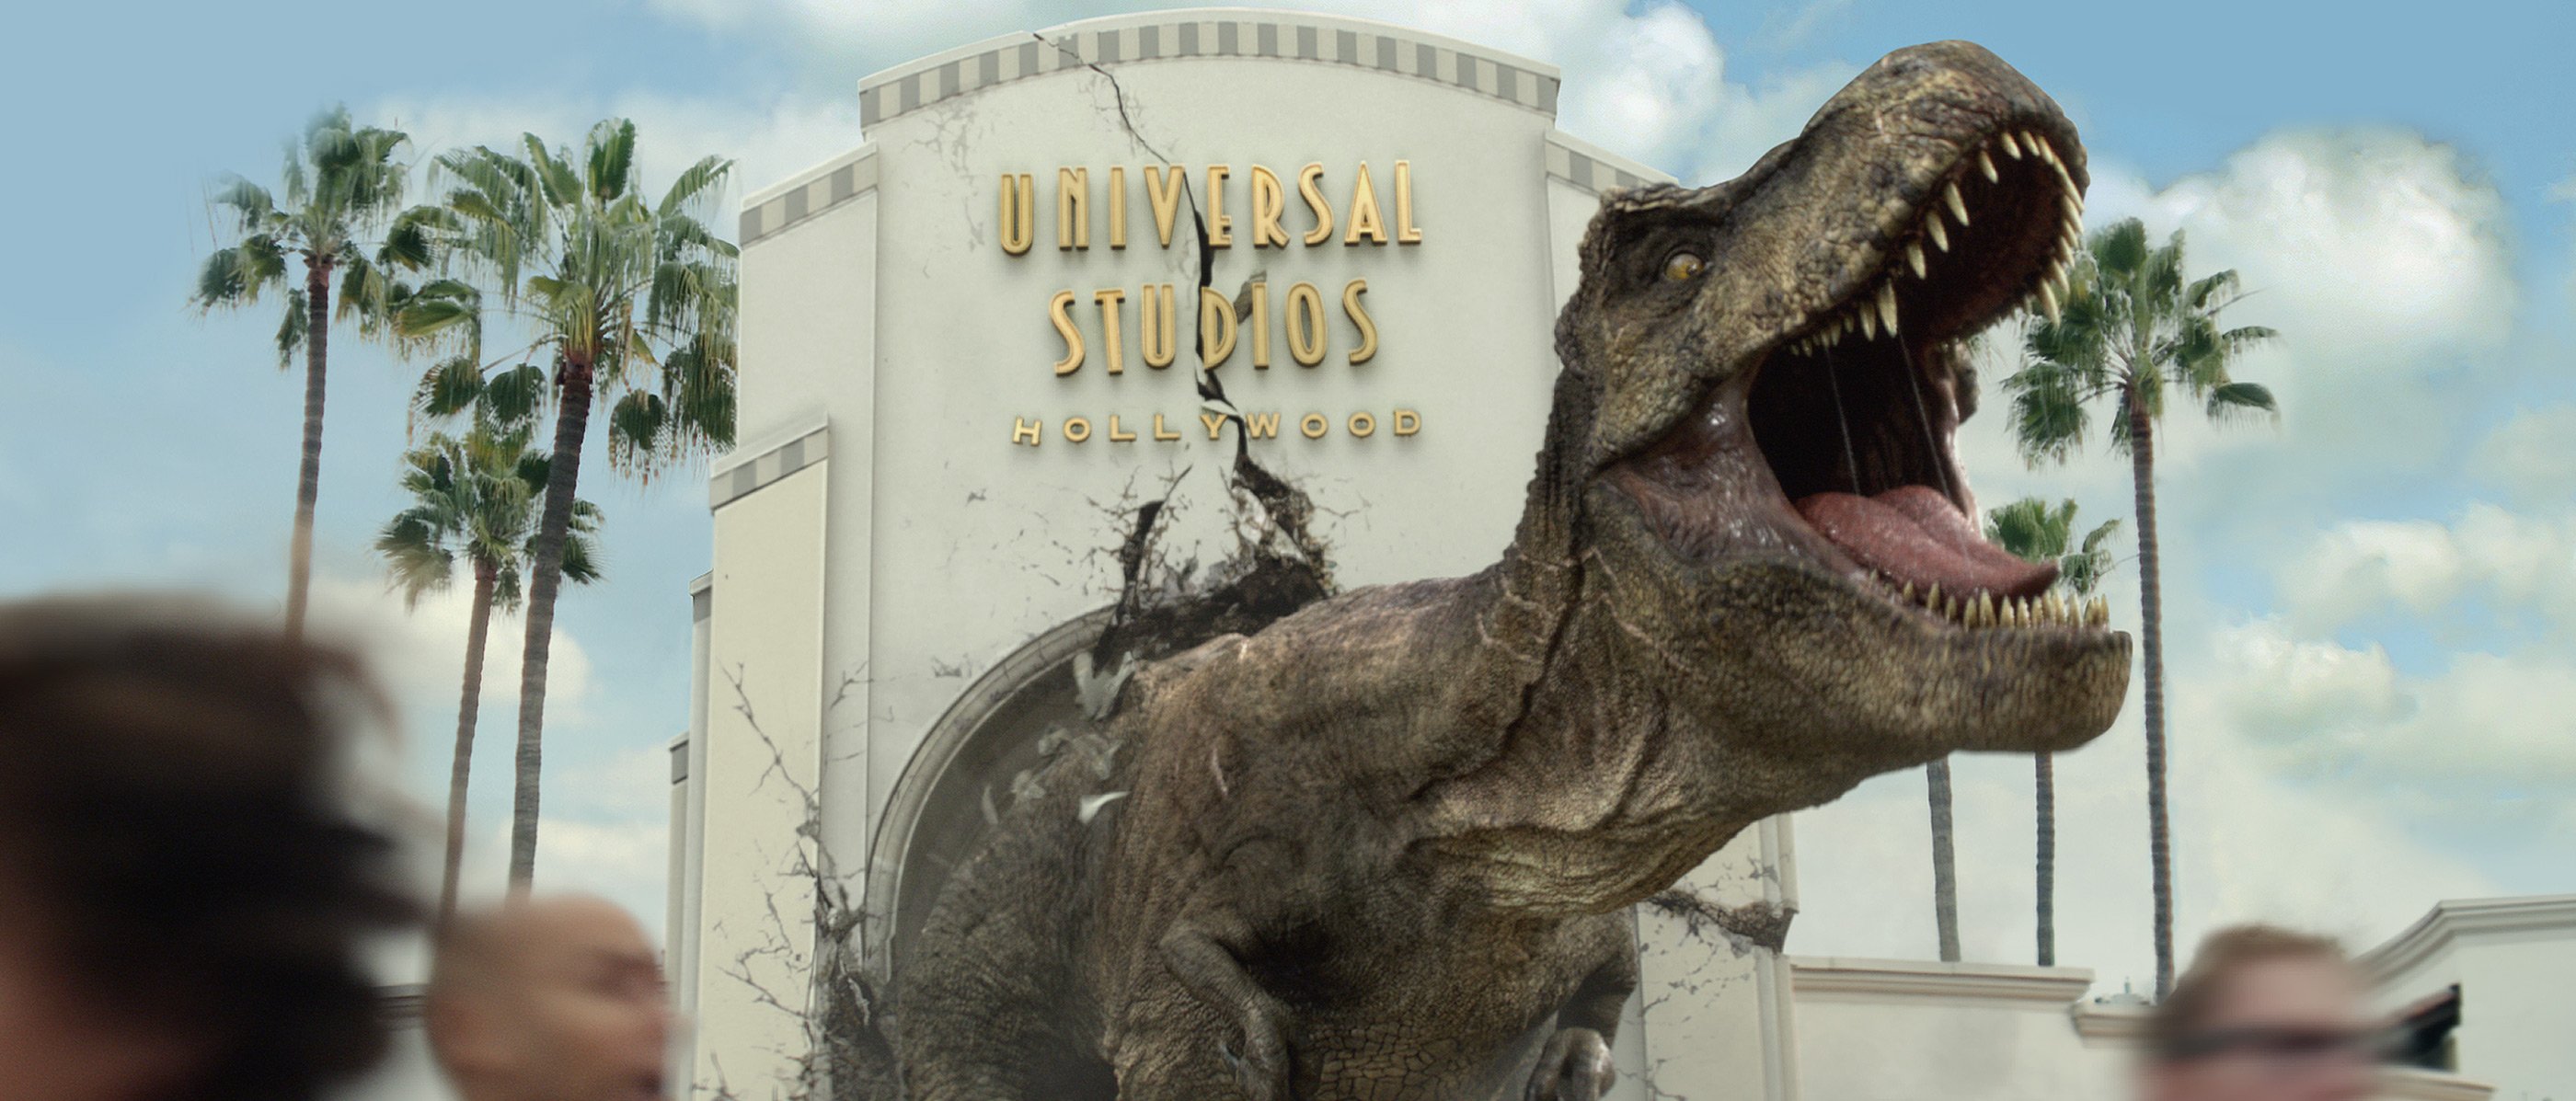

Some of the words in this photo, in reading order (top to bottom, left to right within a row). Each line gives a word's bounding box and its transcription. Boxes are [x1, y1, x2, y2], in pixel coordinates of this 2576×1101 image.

[1000, 160, 1422, 256] UNIVERSAL
[1049, 280, 1378, 375] STUDIOS
[1013, 410, 1421, 446] HOLLYWOOD
